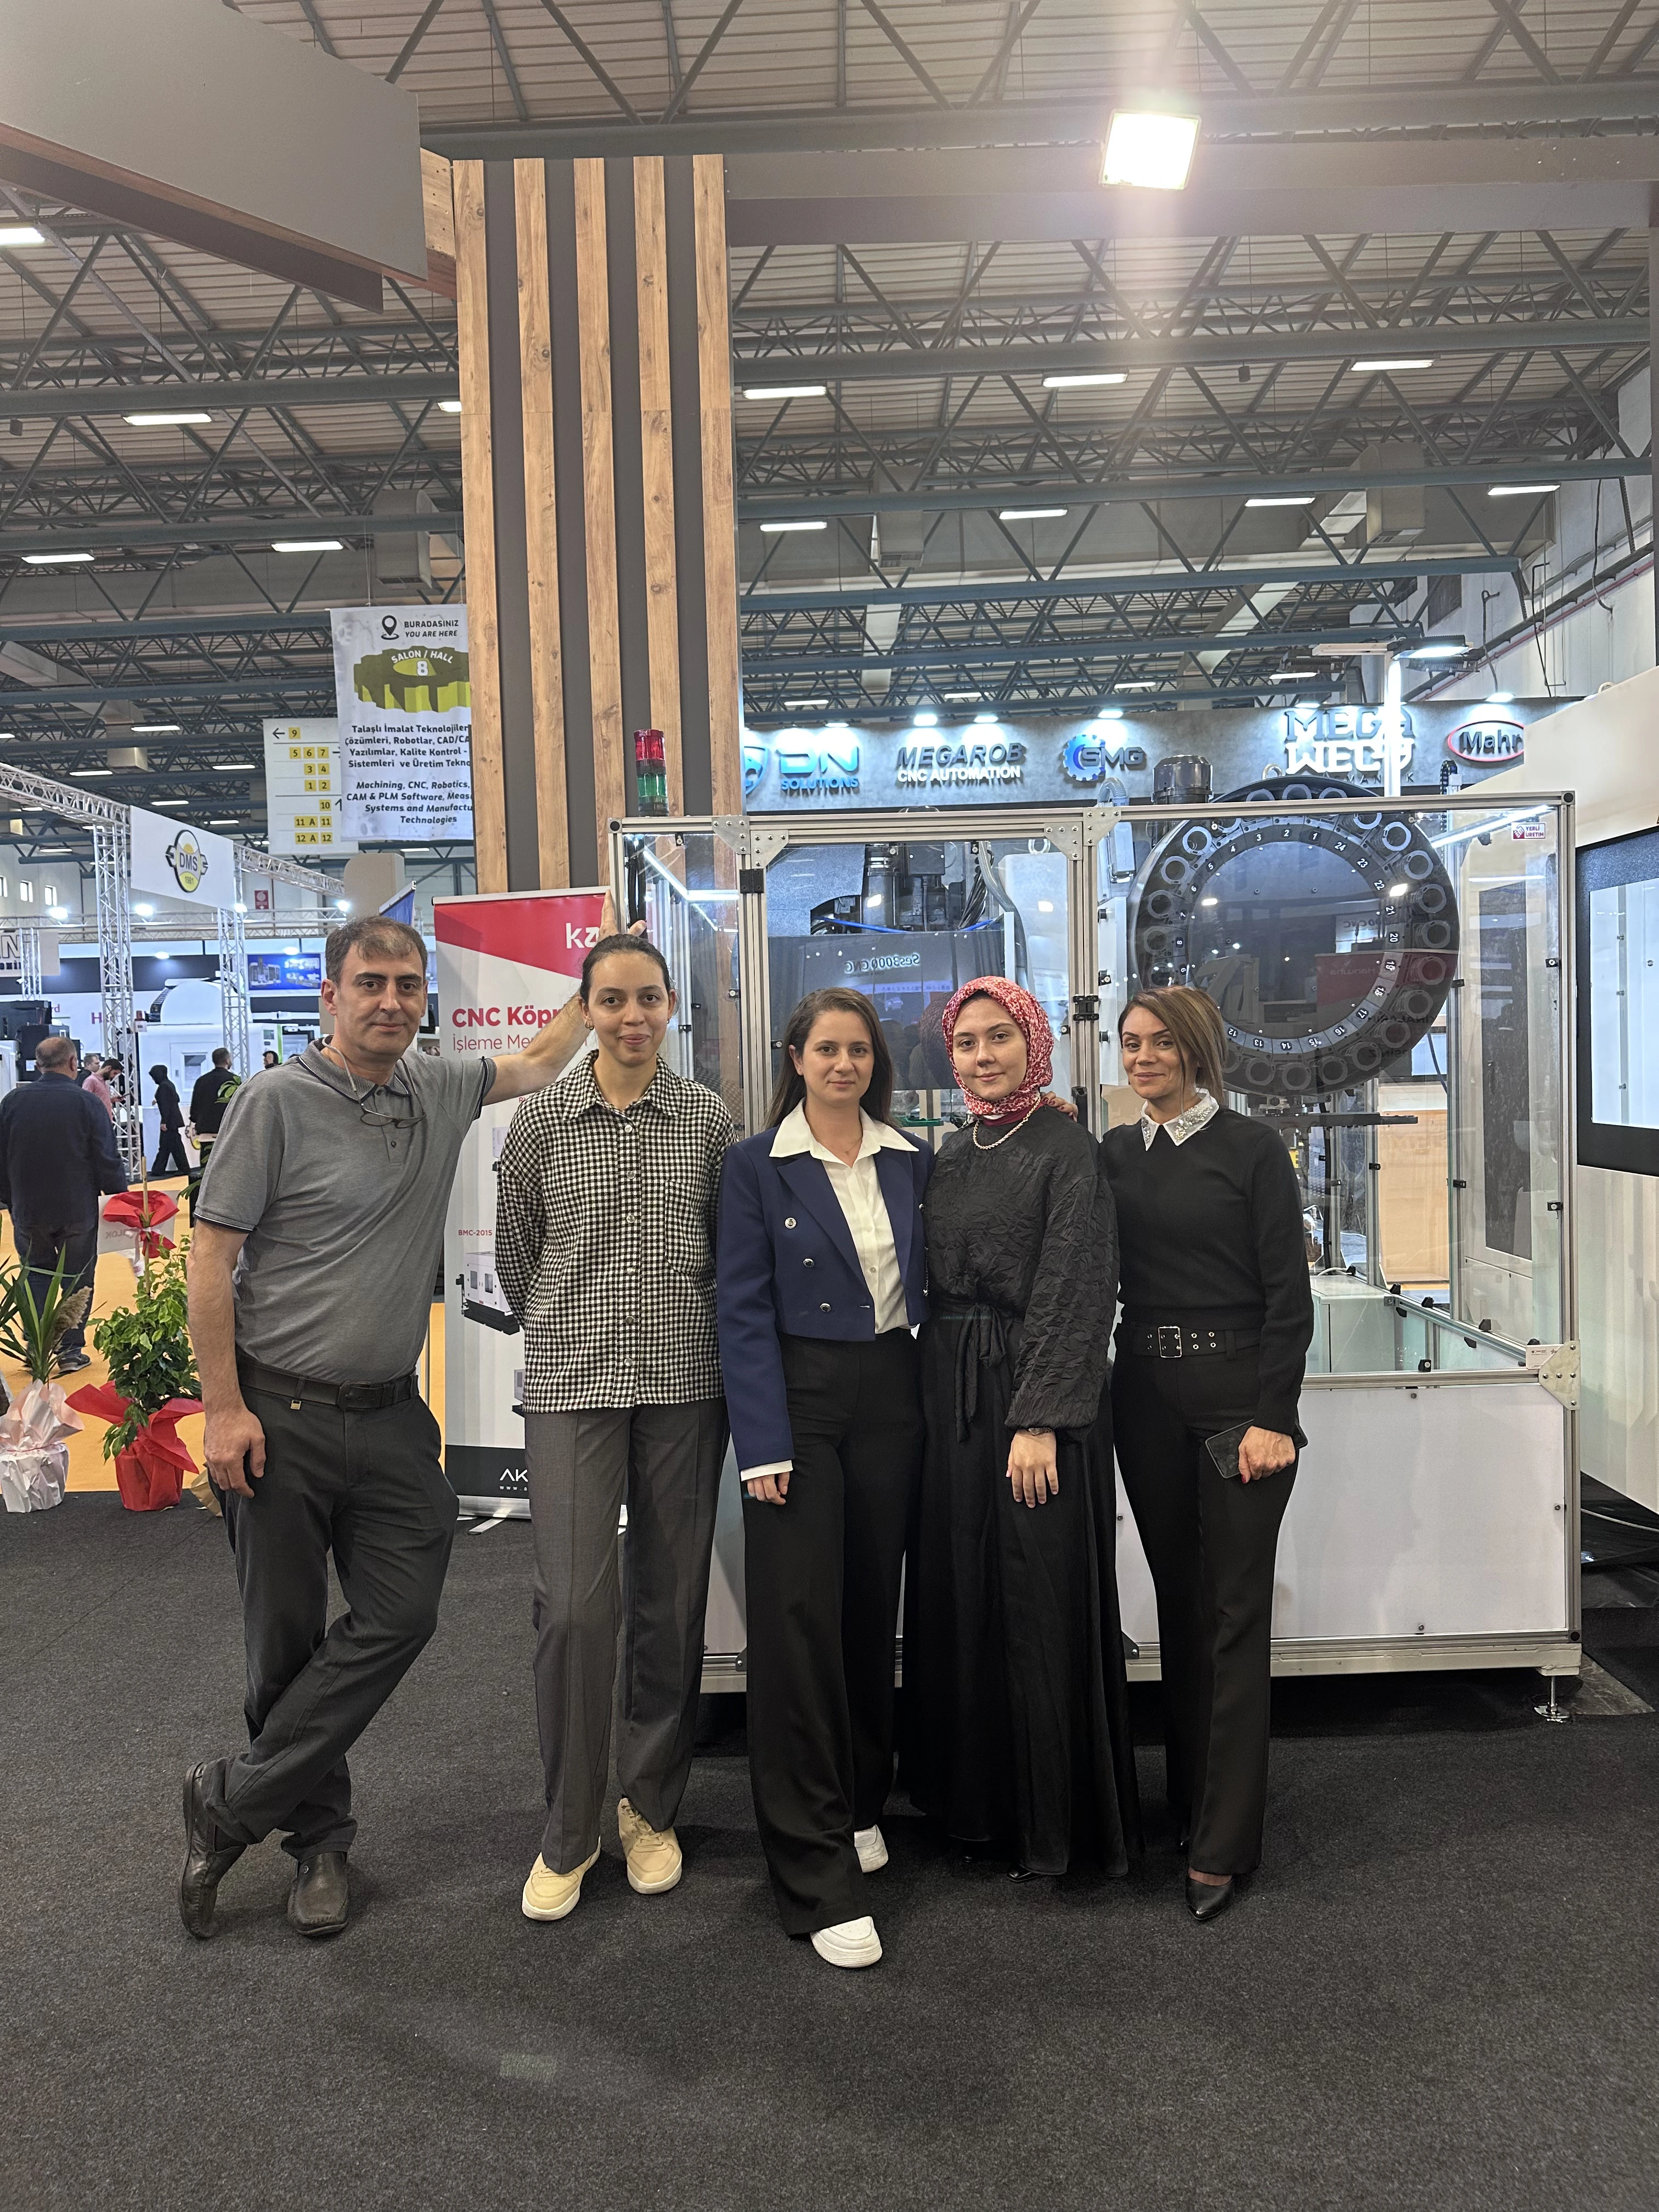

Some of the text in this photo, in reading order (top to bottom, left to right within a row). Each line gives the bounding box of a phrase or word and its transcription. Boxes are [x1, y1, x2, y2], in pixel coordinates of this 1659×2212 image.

[391, 650, 421, 664] SALON
[430, 651, 453, 664] HALL
[417, 661, 428, 676] 8
[352, 725, 381, 733] Talaşlı
[384, 723, 414, 732] İmalat
[345, 736, 391, 746] Çözümleri,
[394, 736, 435, 745] Robotlar,
[1462, 729, 1521, 748] Mahr
[349, 748, 398, 757] Yazılımlar,
[400, 748, 427, 756] Kalite
[430, 747, 461, 756] Kontrol
[897, 743, 1023, 765] MEGAROB
[1082, 747, 1143, 767] SMG
[348, 759, 395, 768] Sistemleri
[413, 758, 444, 768] Üretim
[898, 766, 1021, 782] CNC AUTOMATION
[357, 780, 470, 791] Machining, CNC, Robotics,
[781, 776, 859, 790] SOLUTIONS
[401, 793, 445, 801] Software,
[365, 804, 404, 814] Systems
[400, 815, 458, 825] Technologies
[1334, 842, 1346, 851] 24
[179, 852, 198, 871] DMS
[1357, 858, 1368, 868] 23
[1374, 880, 1385, 890] 22
[1385, 906, 1395, 915] 21
[1390, 933, 1398, 943] 20
[452, 1007, 501, 1028] CNC
[1358, 1009, 1367, 1018] 17
[1228, 1028, 1237, 1036] 12
[1335, 1026, 1345, 1035] 16
[453, 1034, 502, 1053] İşleme
